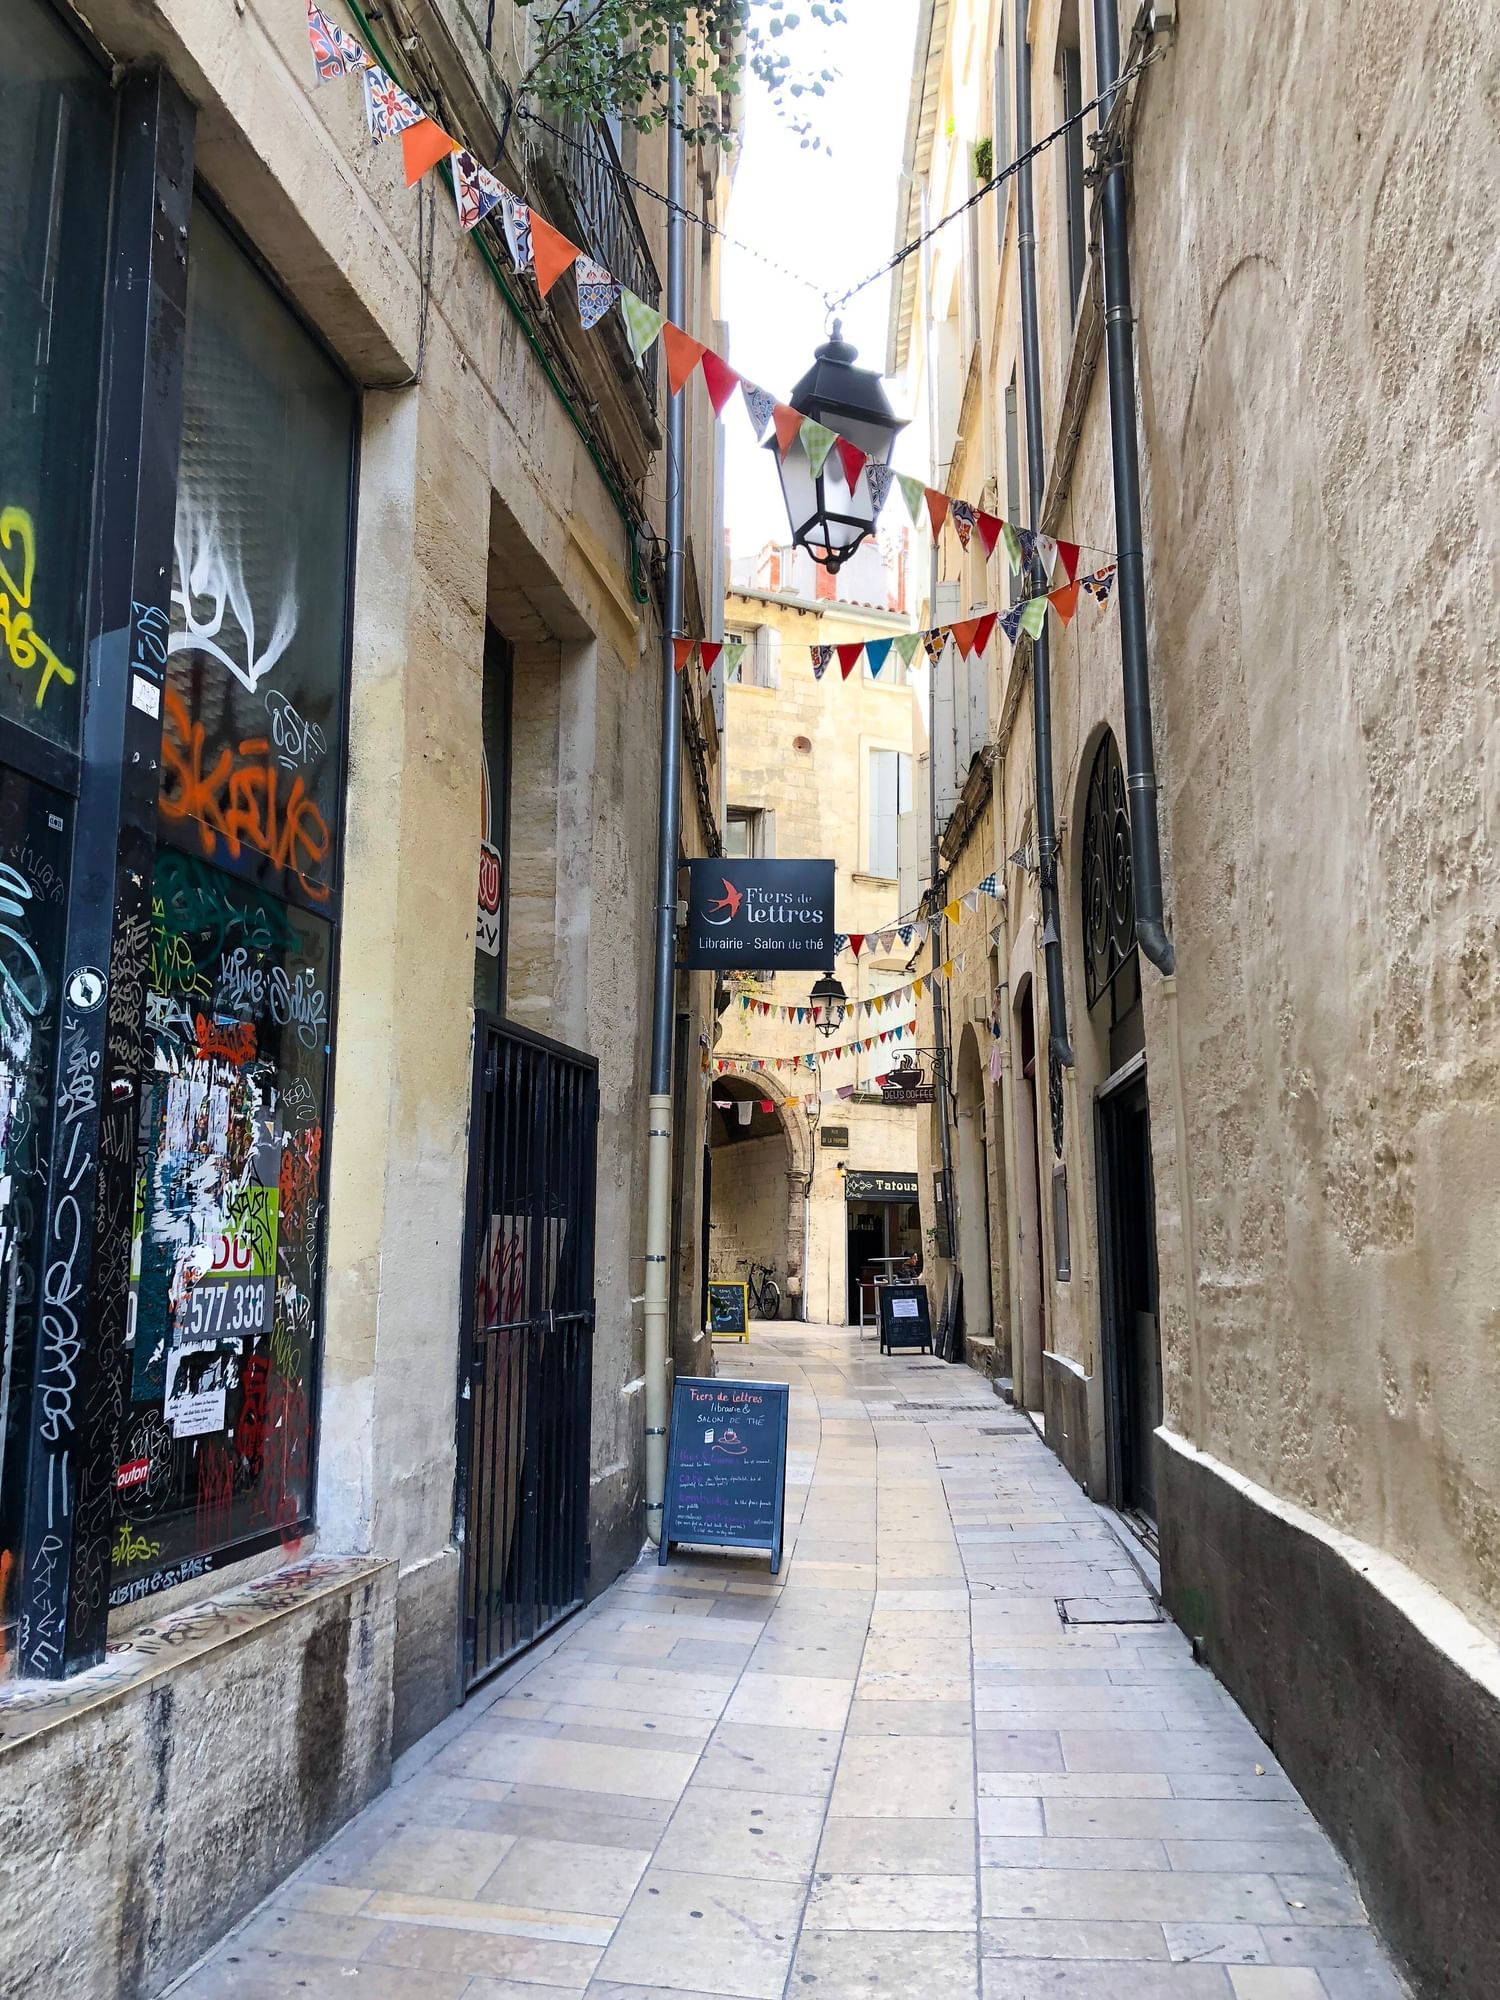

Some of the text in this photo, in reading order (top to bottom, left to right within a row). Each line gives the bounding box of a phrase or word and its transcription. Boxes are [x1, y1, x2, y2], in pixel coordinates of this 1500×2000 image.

[746, 888, 812, 904] Fiers de
[746, 904, 824, 924] lettres
[699, 937, 743, 950] Librairie
[754, 937, 785, 950] Salon
[788, 938, 801, 950] de
[805, 937, 824, 950] thé
[906, 1089, 933, 1099] COFFEE
[690, 1388, 763, 1404] Fiers de lettres
[696, 1414, 724, 1423] SALON
[747, 1414, 765, 1426] THÉ
